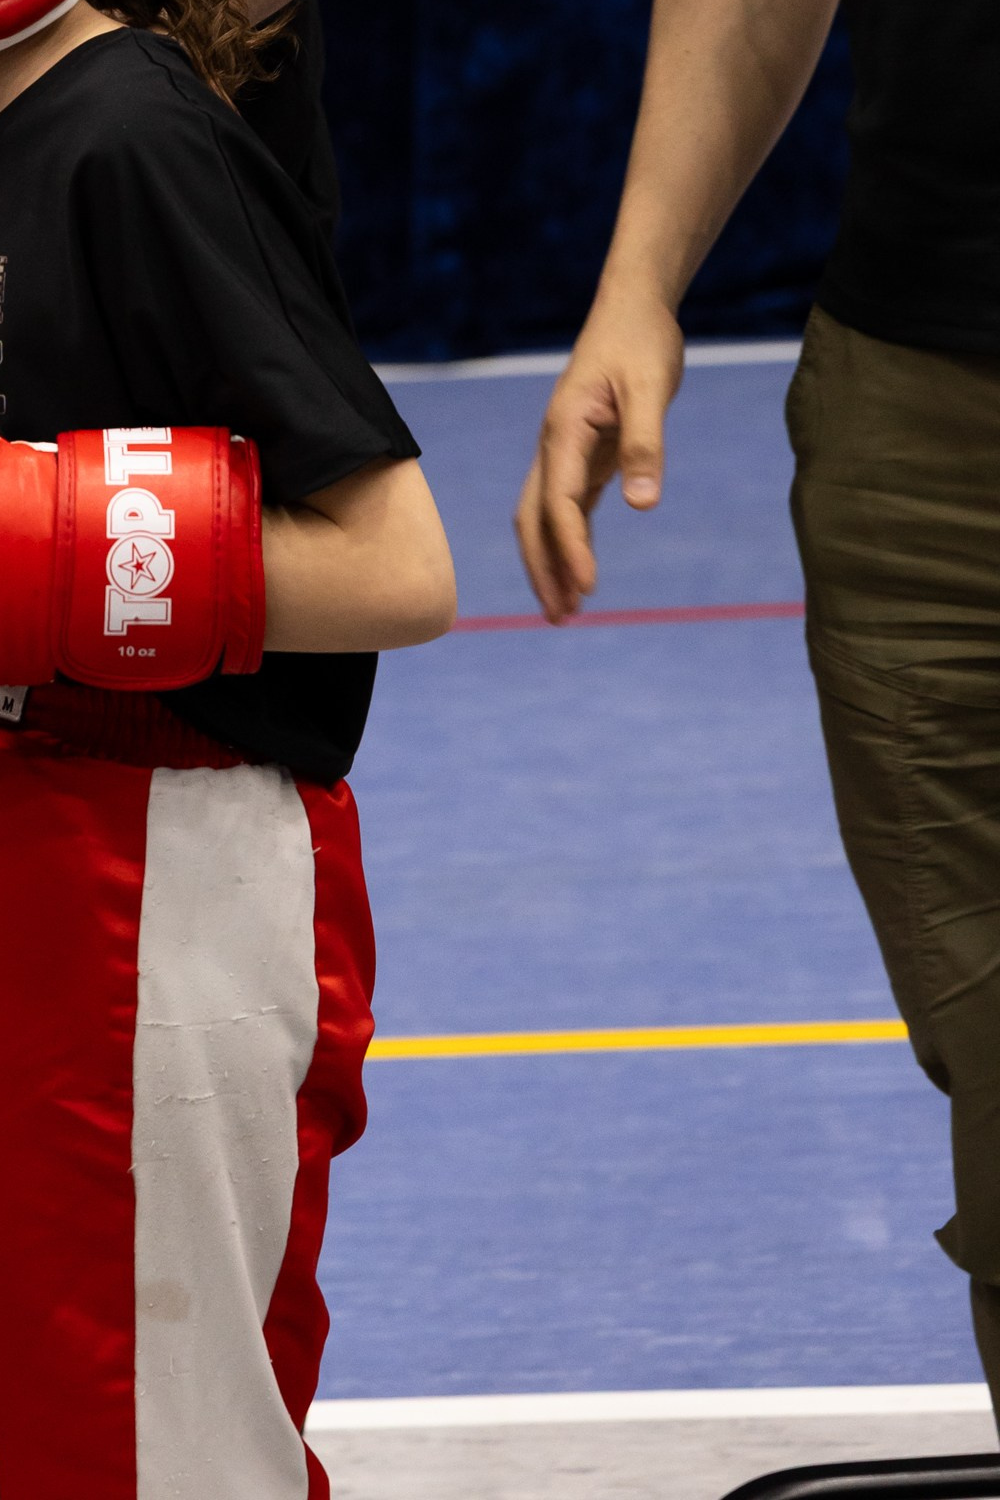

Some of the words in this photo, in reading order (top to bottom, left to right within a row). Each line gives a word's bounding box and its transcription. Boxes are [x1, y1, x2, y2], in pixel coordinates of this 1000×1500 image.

[104, 487, 175, 636] TOP
[118, 645, 135, 657] 10
[138, 648, 156, 657] oz
